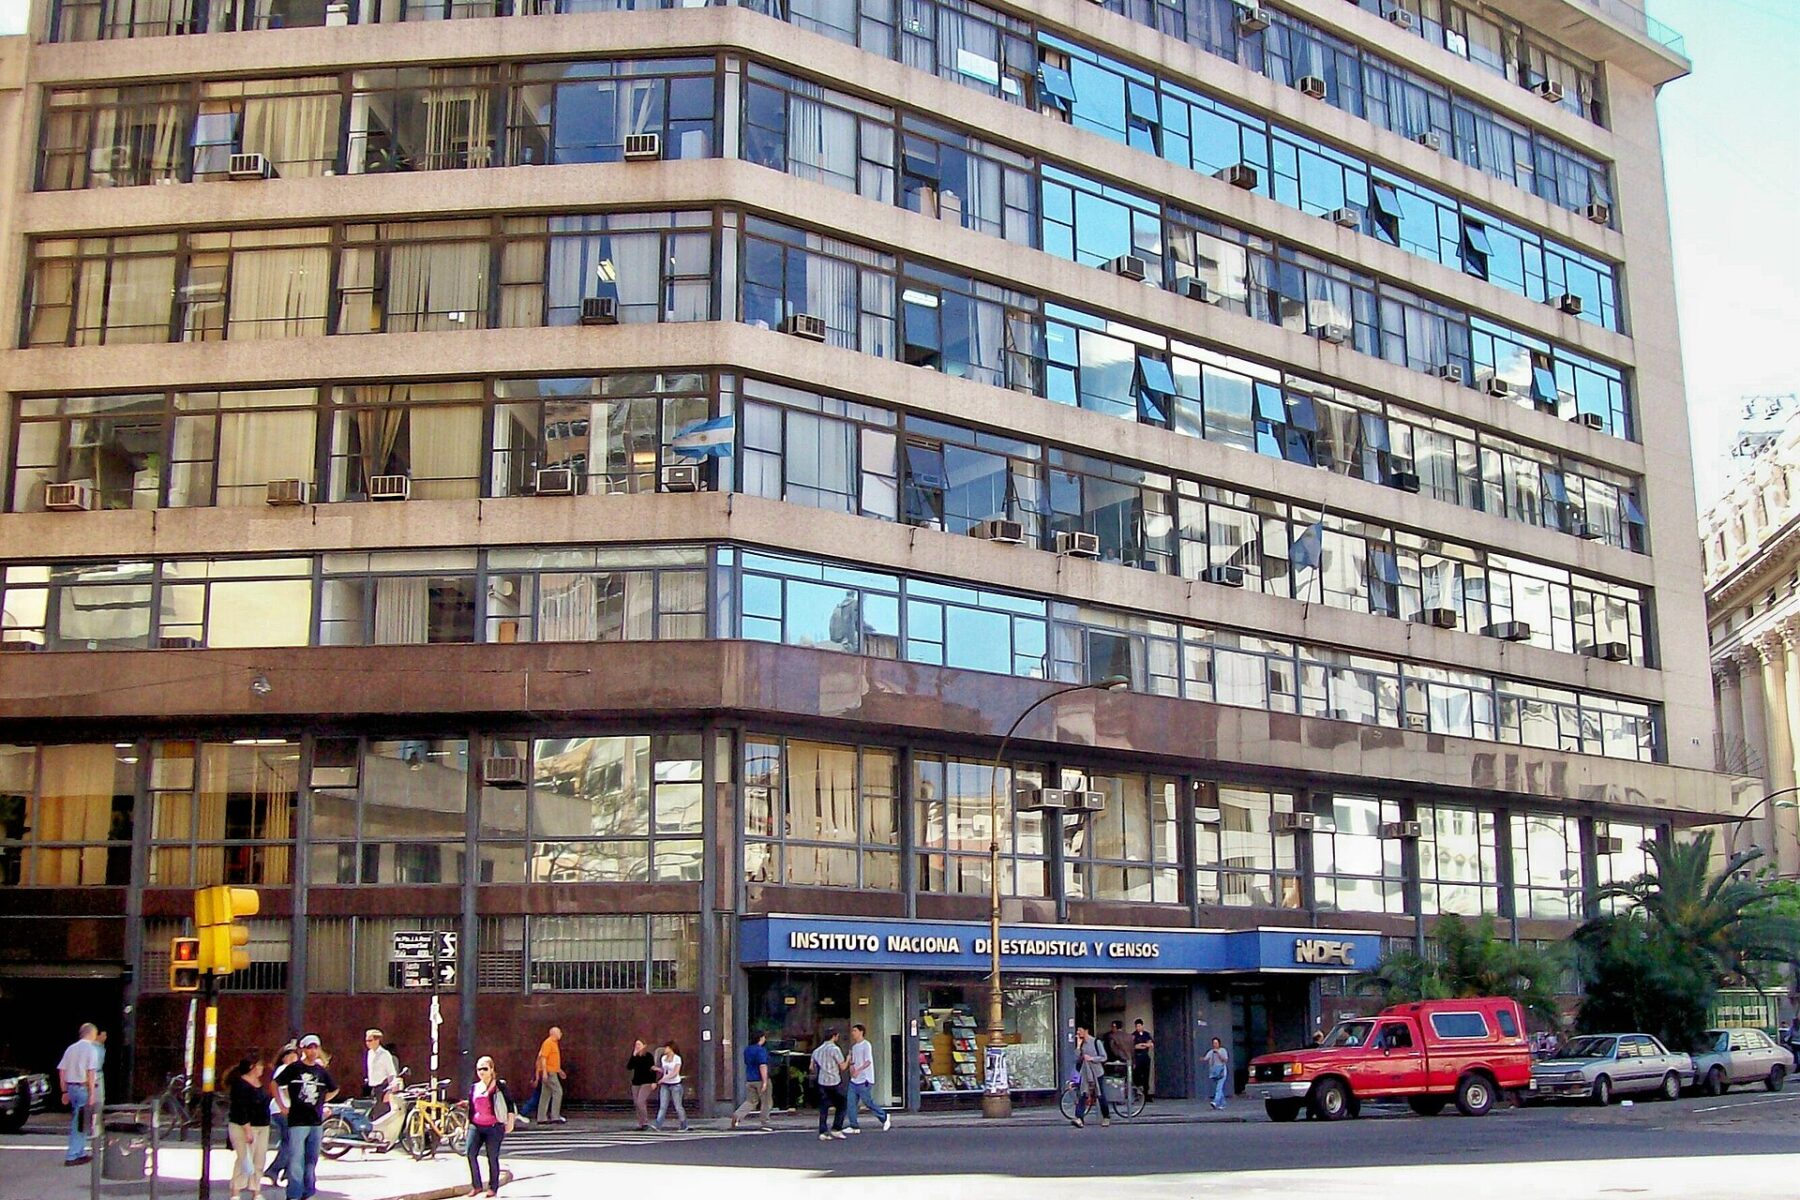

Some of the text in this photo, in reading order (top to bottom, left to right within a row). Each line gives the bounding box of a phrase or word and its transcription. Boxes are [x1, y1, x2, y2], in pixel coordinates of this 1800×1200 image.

[790, 932, 879, 952] INSTITUTO
[887, 935, 959, 953] NACIONA
[1001, 939, 1088, 957] ESTADISTICA
[1094, 942, 1103, 957] Y
[1109, 942, 1159, 958] CENSOS
